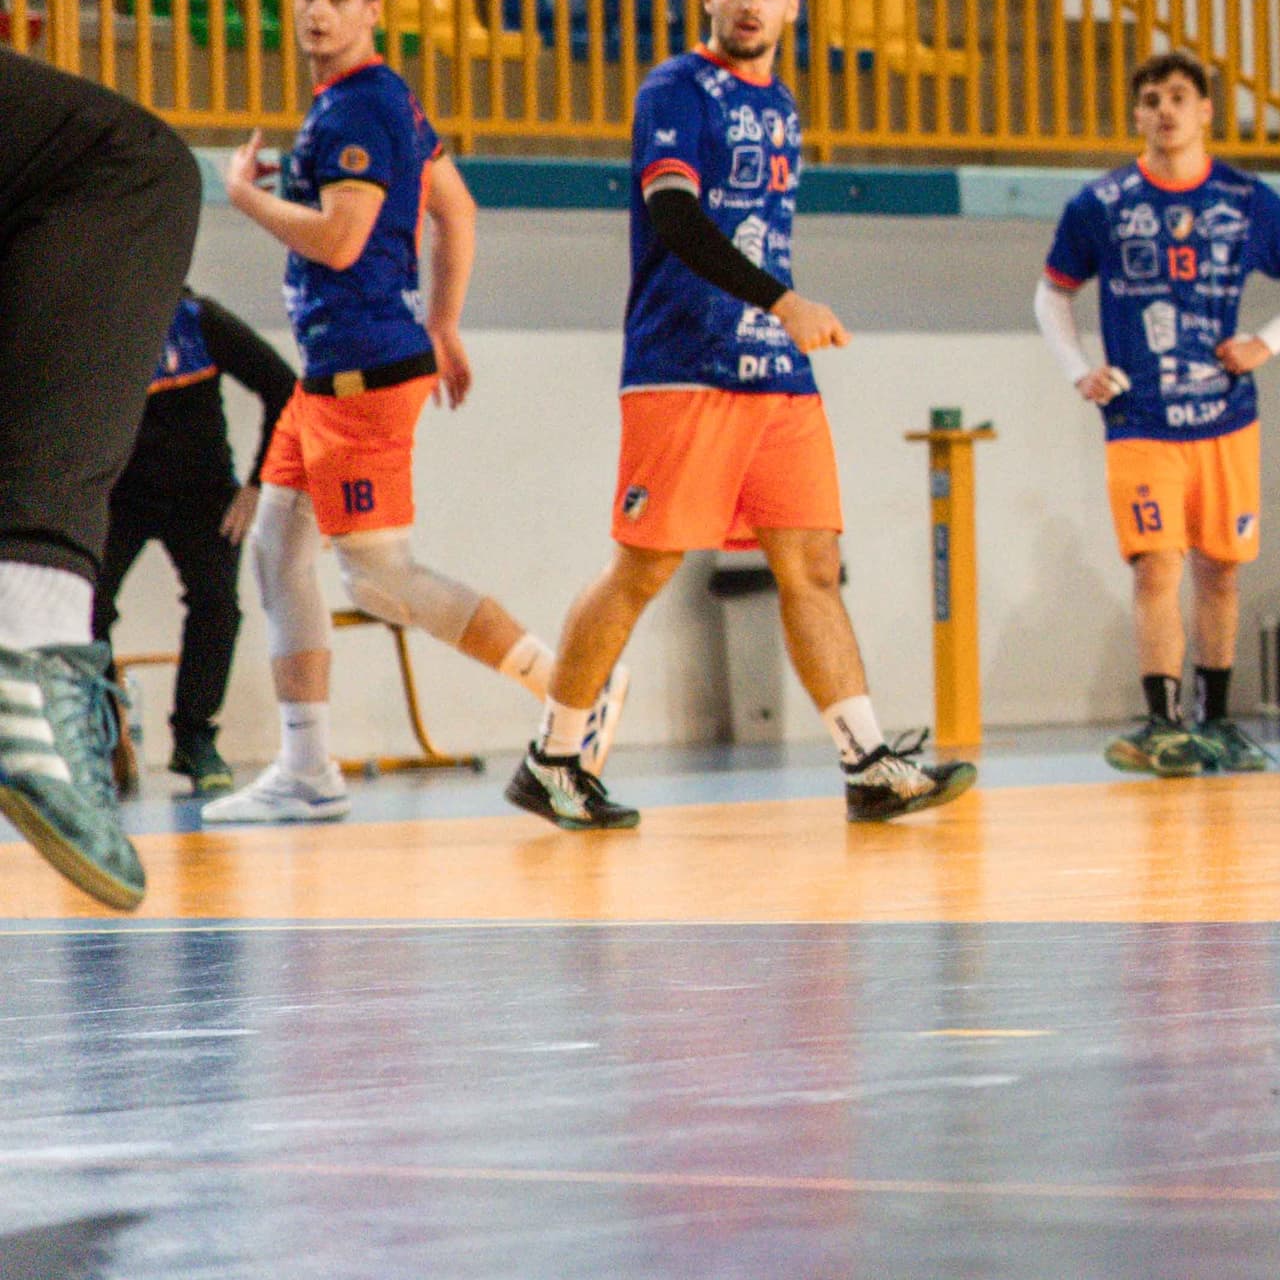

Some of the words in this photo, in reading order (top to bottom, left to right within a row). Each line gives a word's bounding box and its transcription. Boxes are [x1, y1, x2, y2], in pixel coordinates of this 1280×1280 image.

[1166, 245, 1198, 282] 13
[342, 478, 375, 515] 18
[1131, 500, 1163, 536] 13
